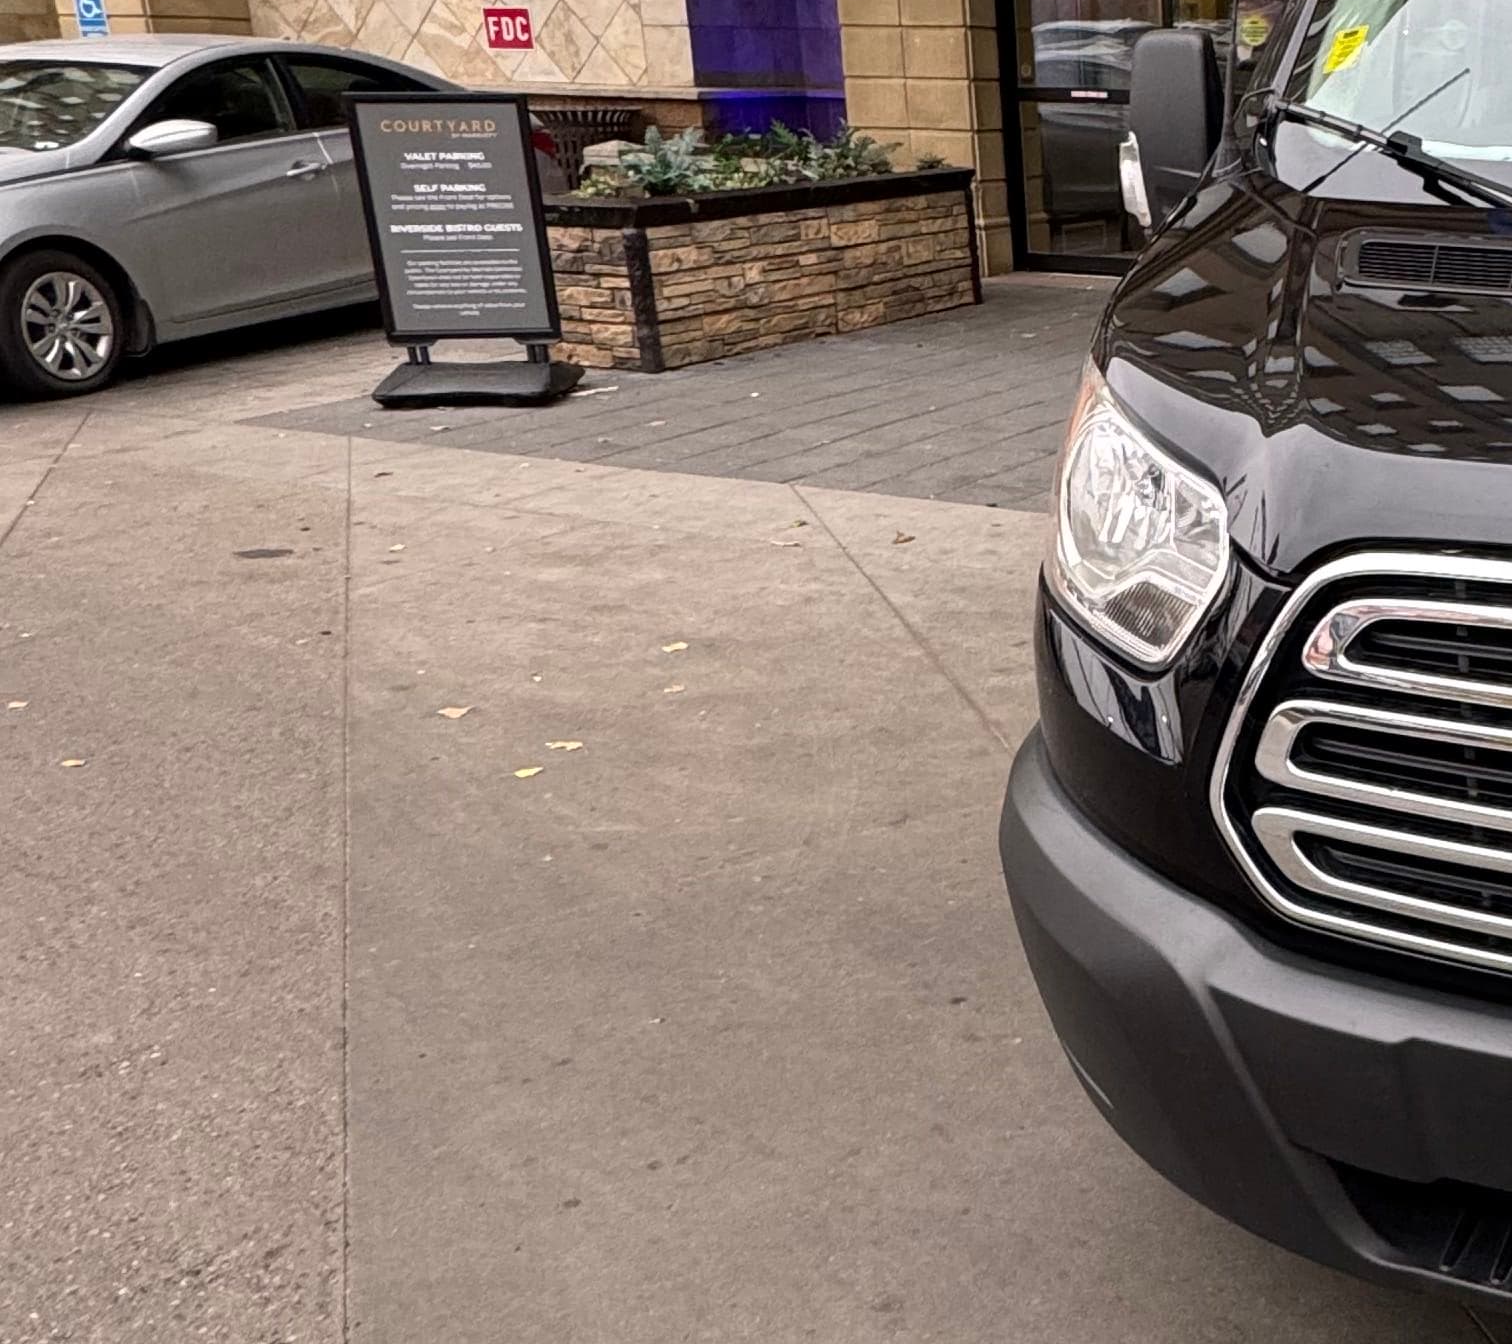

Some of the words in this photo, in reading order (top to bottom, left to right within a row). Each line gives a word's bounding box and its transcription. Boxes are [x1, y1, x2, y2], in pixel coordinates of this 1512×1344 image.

[487, 16, 530, 41] FDC
[380, 119, 497, 133] COURTYARD
[404, 152, 437, 161] VALET
[438, 152, 485, 161] PARKING
[413, 184, 438, 192] SELF
[440, 183, 487, 192] PARKING
[390, 224, 444, 233] RIVERSIDE
[445, 224, 482, 233] BISTRO
[484, 223, 523, 233] GUESTS
